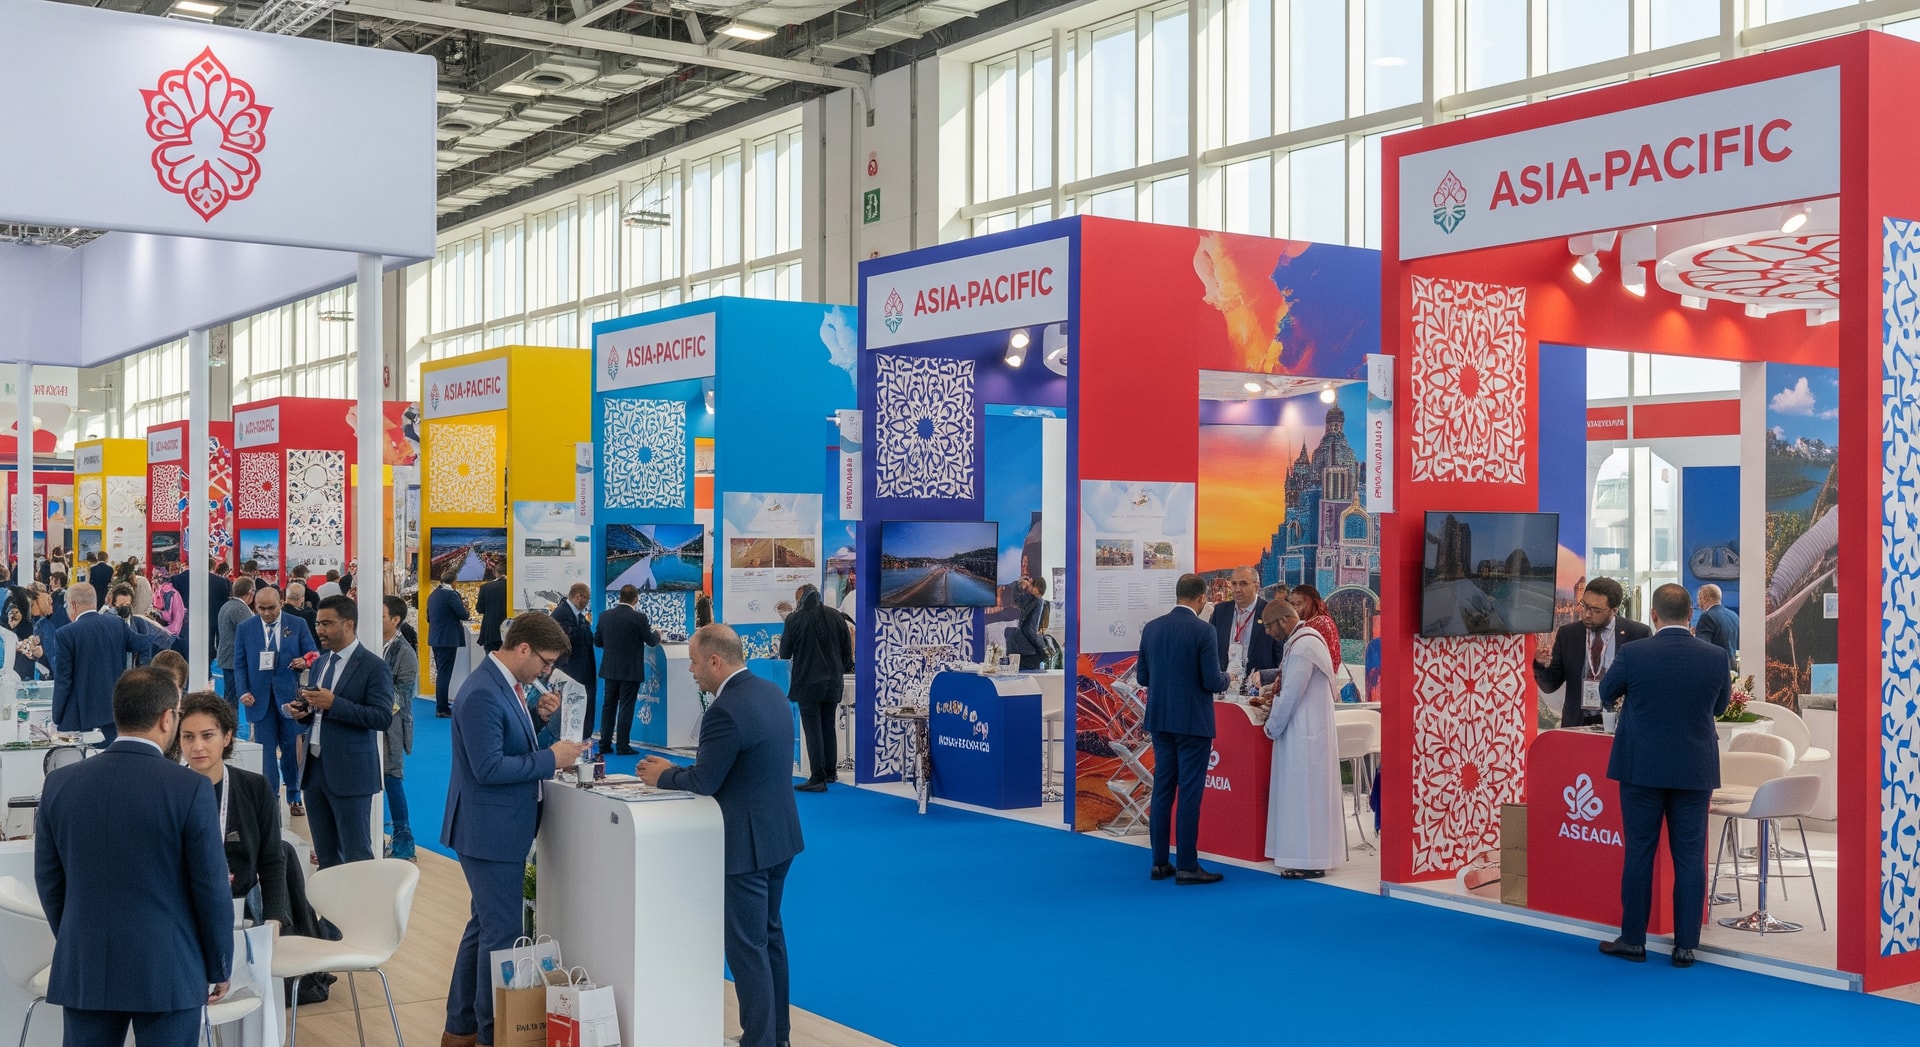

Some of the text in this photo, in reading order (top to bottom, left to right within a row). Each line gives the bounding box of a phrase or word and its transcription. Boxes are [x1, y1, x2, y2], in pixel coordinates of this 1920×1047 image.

[1489, 118, 1793, 211] ASIA-PACIFIC
[914, 267, 1053, 316] ASIA-PACIFIC
[626, 335, 706, 368] ASIA-PACIFIC
[444, 376, 501, 401] ASIA-PACIFIC
